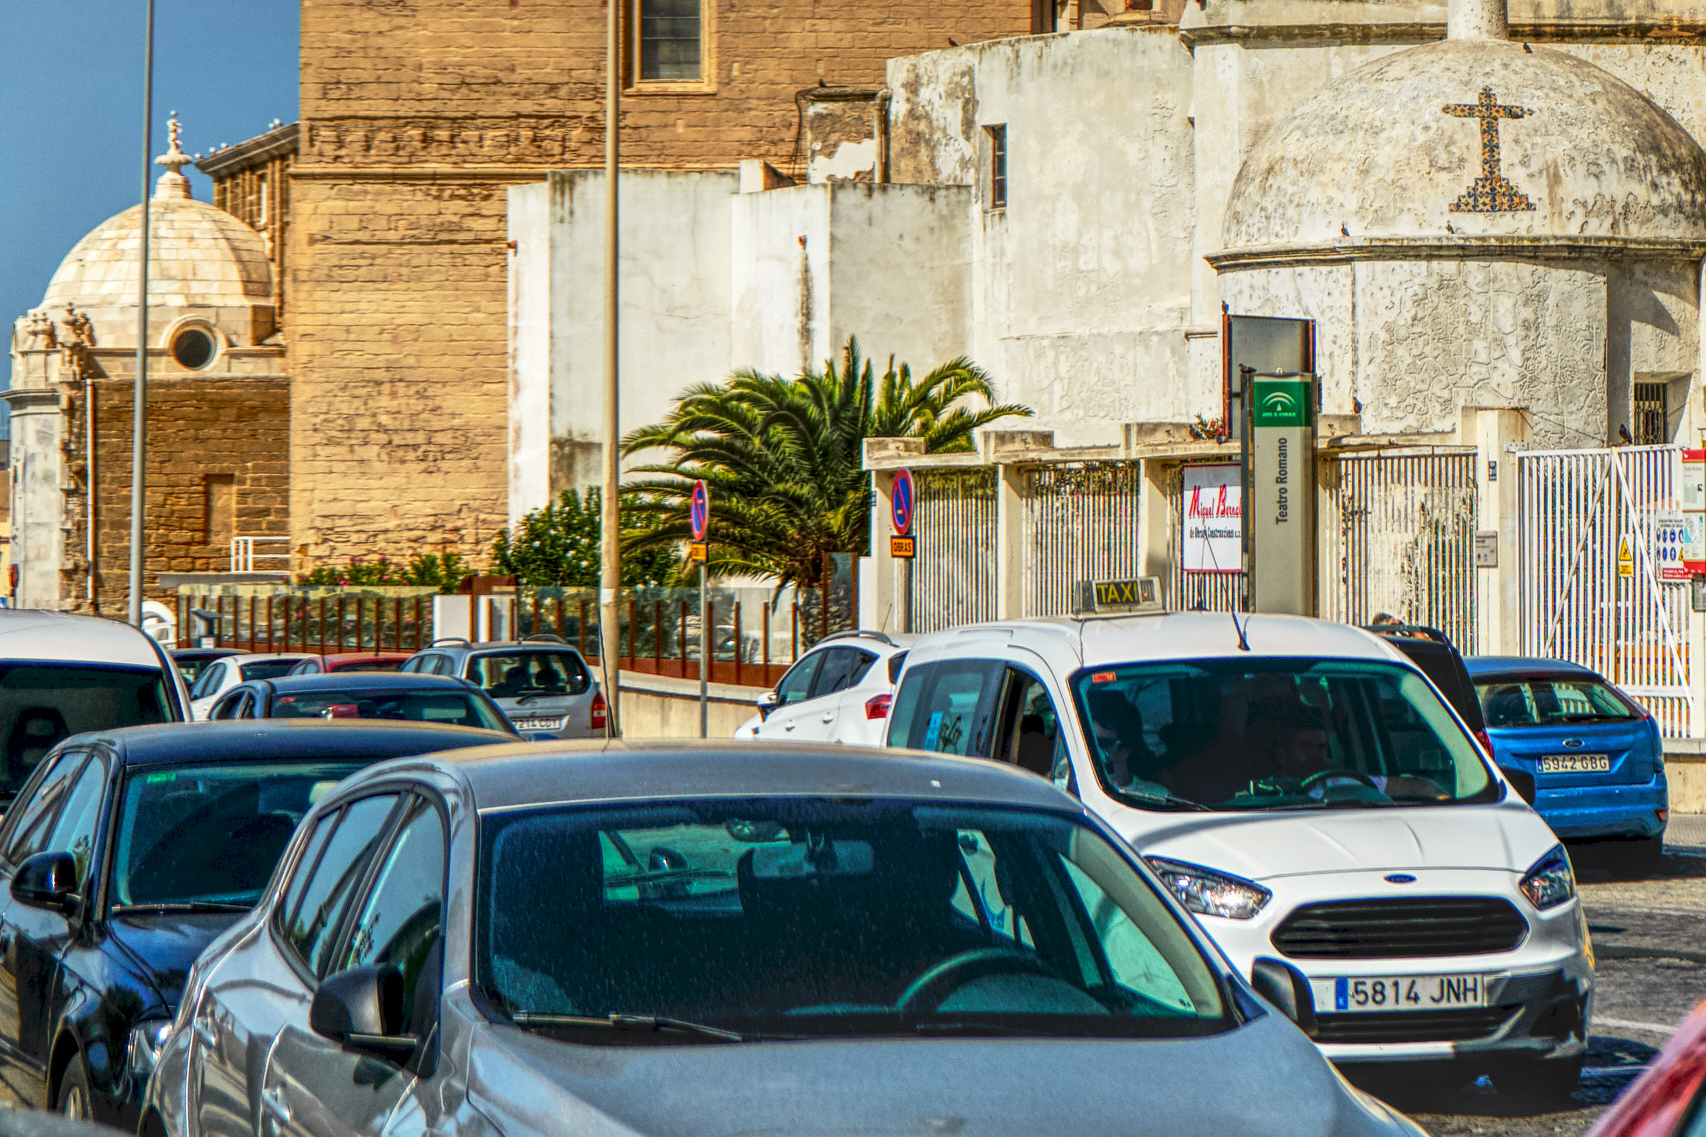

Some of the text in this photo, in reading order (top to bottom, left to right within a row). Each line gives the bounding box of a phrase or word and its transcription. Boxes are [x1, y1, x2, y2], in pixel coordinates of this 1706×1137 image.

[1275, 437, 1288, 525] Teatro Romano
[1189, 484, 1215, 525] Miguel
[893, 541, 912, 553] OBRAS
[1096, 582, 1139, 604] TAXI
[1543, 755, 1577, 771] 5942
[1338, 976, 1479, 1007] E 5814 JNH
